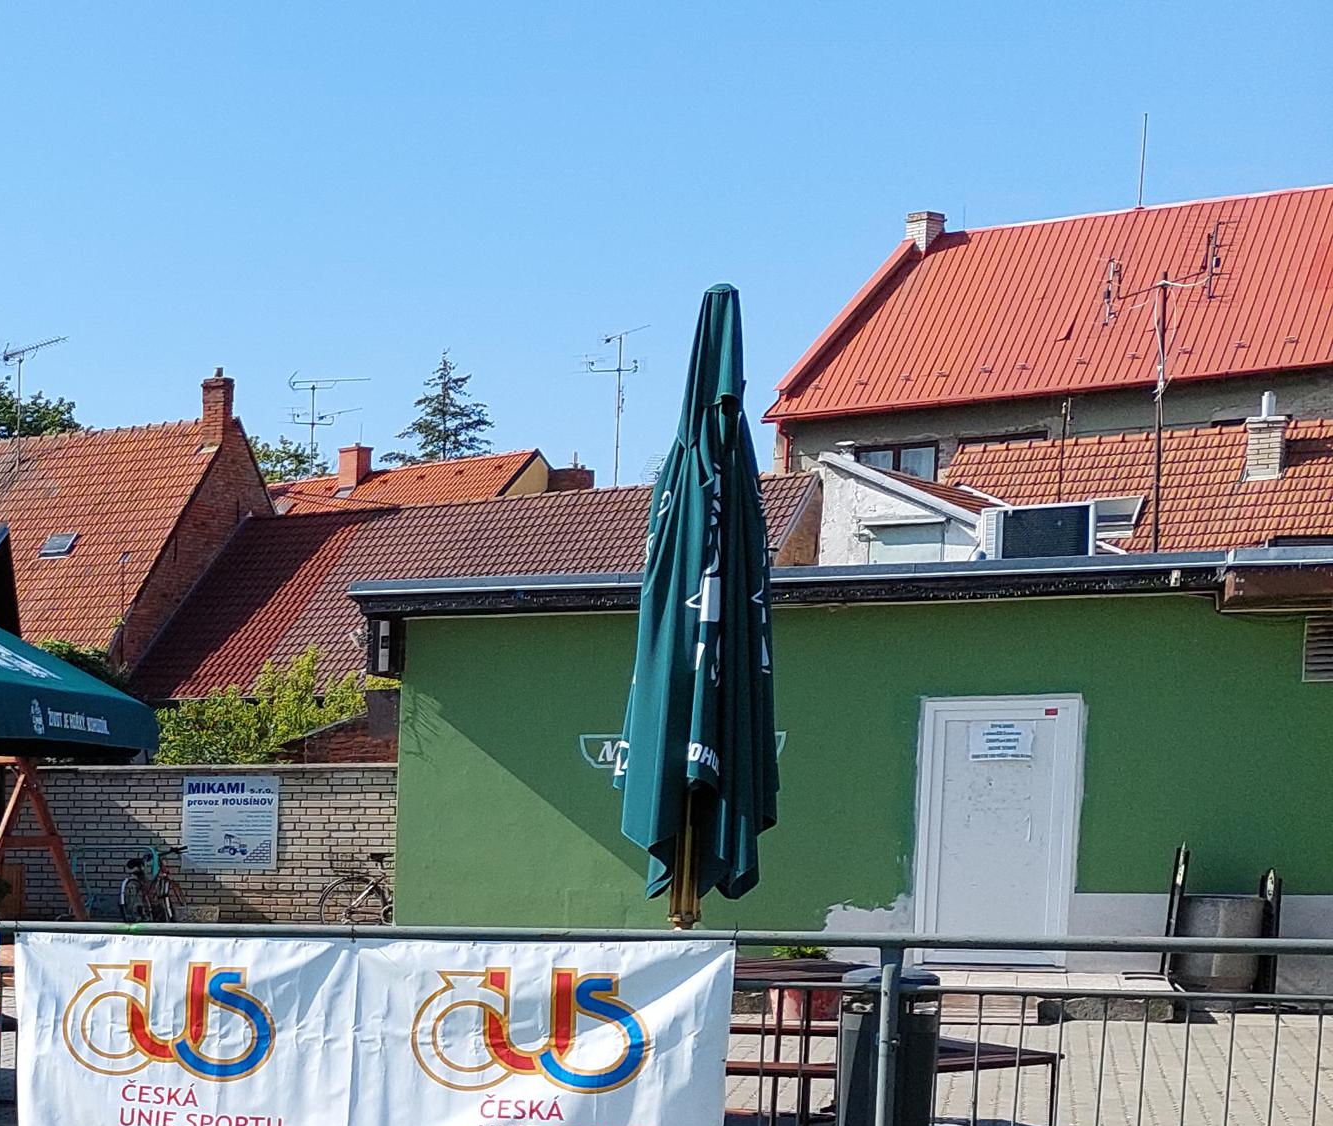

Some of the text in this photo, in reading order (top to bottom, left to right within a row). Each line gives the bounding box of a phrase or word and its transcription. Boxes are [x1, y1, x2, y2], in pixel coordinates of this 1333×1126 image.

[188, 782, 245, 794] MIKAMI
[187, 799, 219, 807] provoz
[121, 1079, 199, 1107] ČESKÁ
[480, 1094, 564, 1121] ČESKÁ
